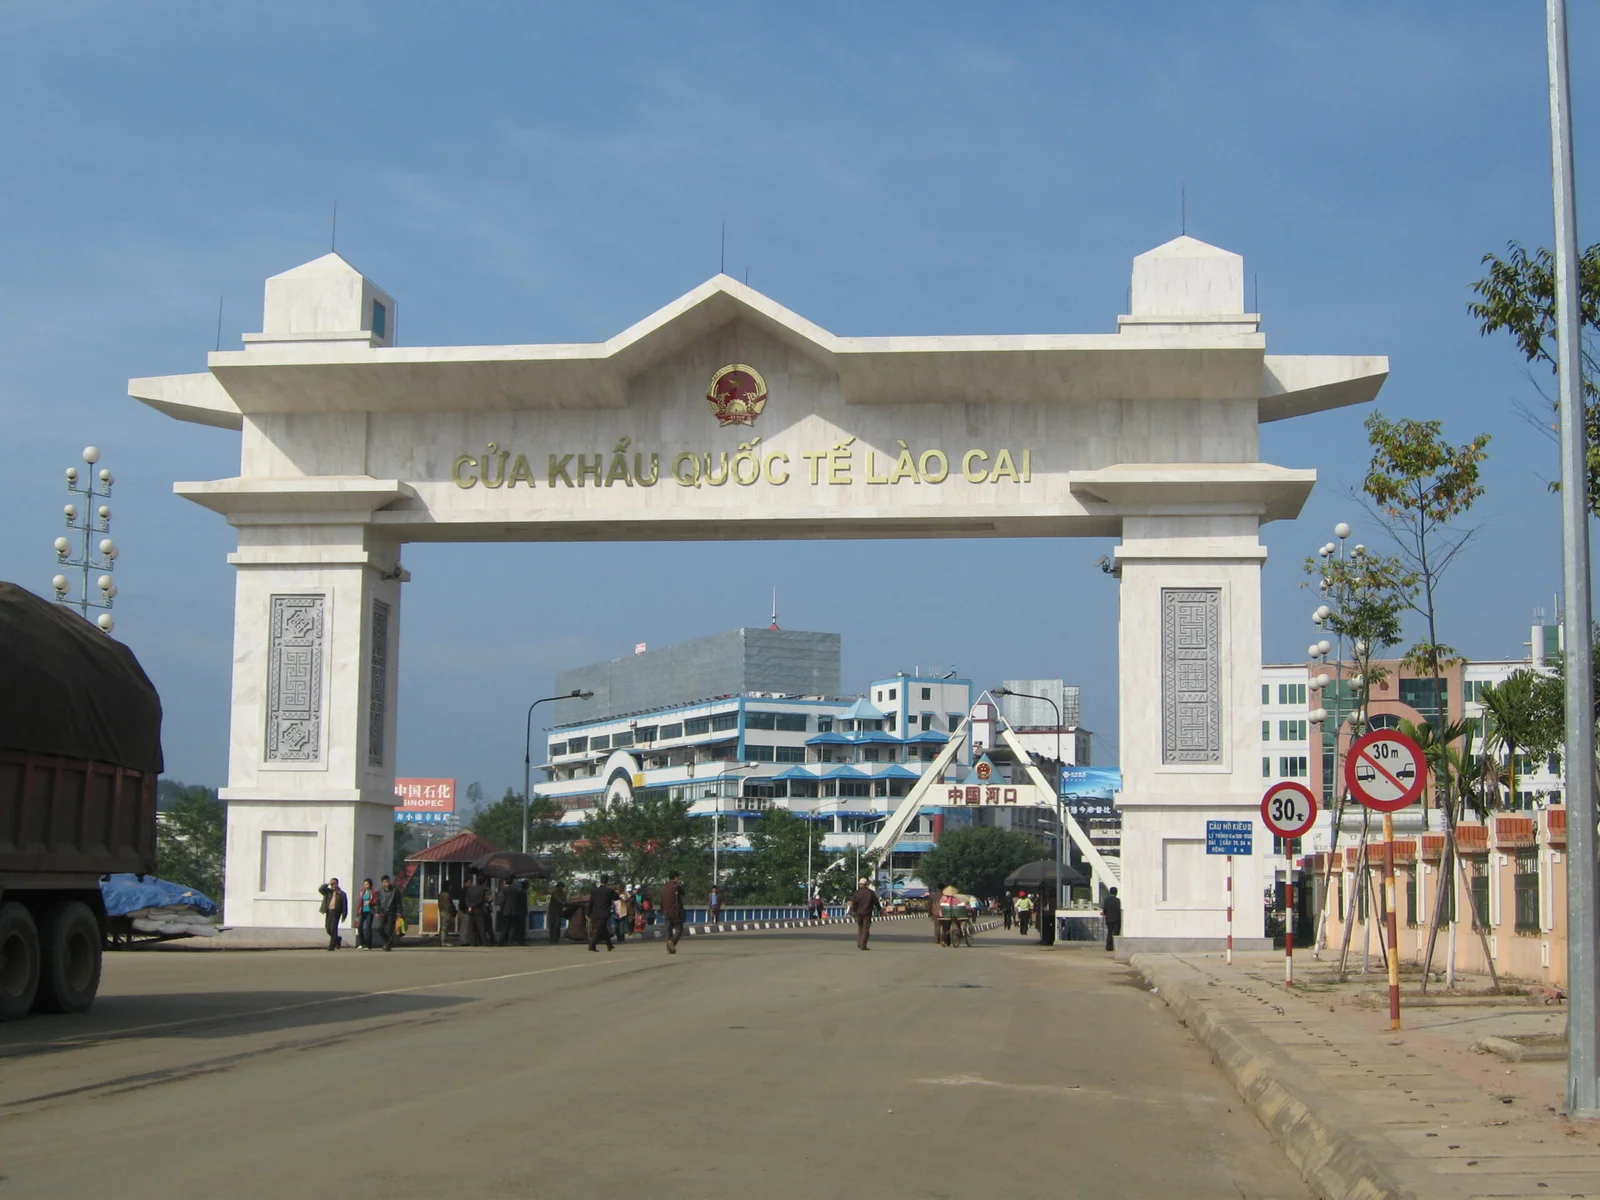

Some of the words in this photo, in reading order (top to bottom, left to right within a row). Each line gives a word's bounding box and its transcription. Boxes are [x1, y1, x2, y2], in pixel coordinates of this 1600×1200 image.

[452, 441, 536, 489] CỬA
[548, 435, 660, 488] KHẨU
[672, 436, 790, 490] QUỐC
[803, 436, 855, 485] TẾ
[866, 440, 949, 485] LÀO
[961, 448, 1032, 484] CAI
[394, 784, 451, 799] 中国石化
[948, 786, 1018, 805] 中国河口
